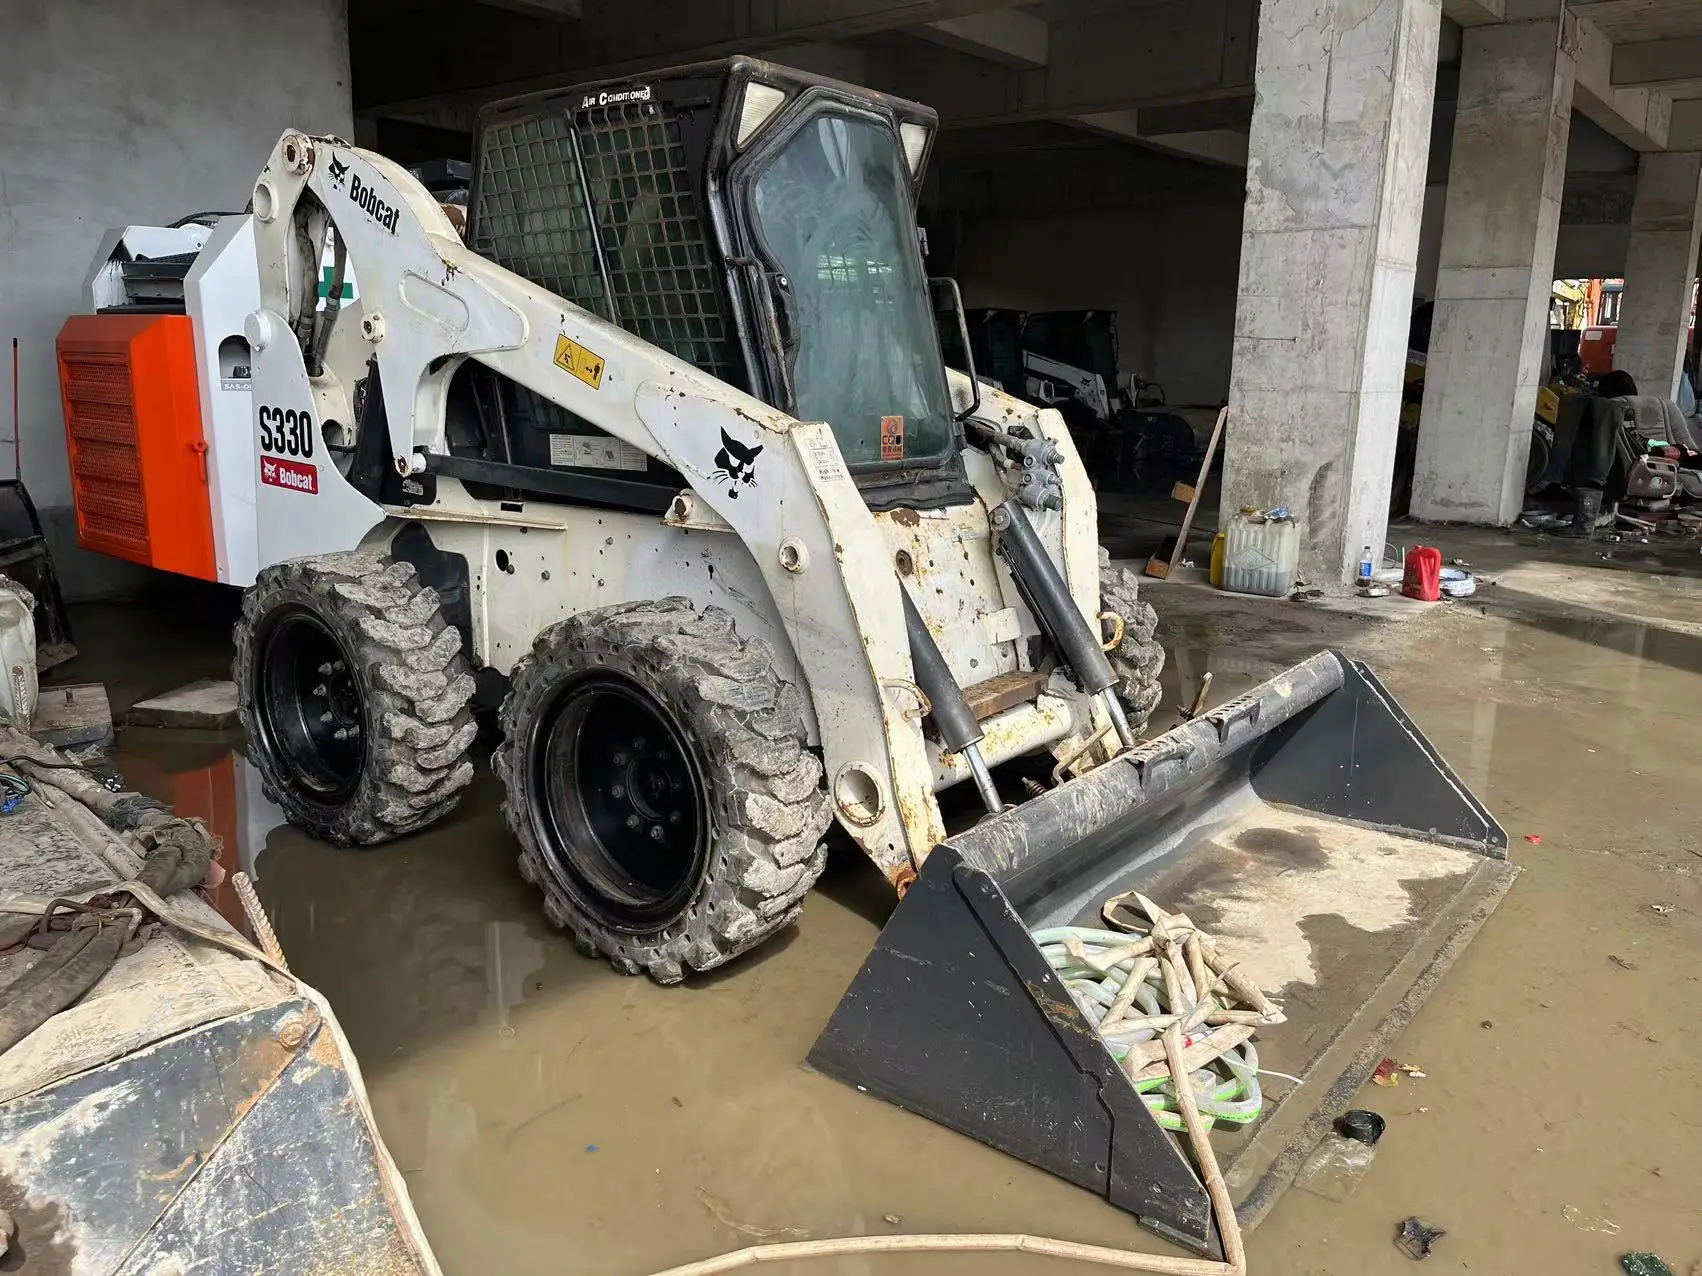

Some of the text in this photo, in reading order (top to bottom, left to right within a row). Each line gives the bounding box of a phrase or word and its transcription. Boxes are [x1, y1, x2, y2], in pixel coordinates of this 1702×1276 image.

[349, 173, 400, 235] Bobcat
[259, 405, 314, 459] S330
[279, 467, 314, 491] Bobcat
